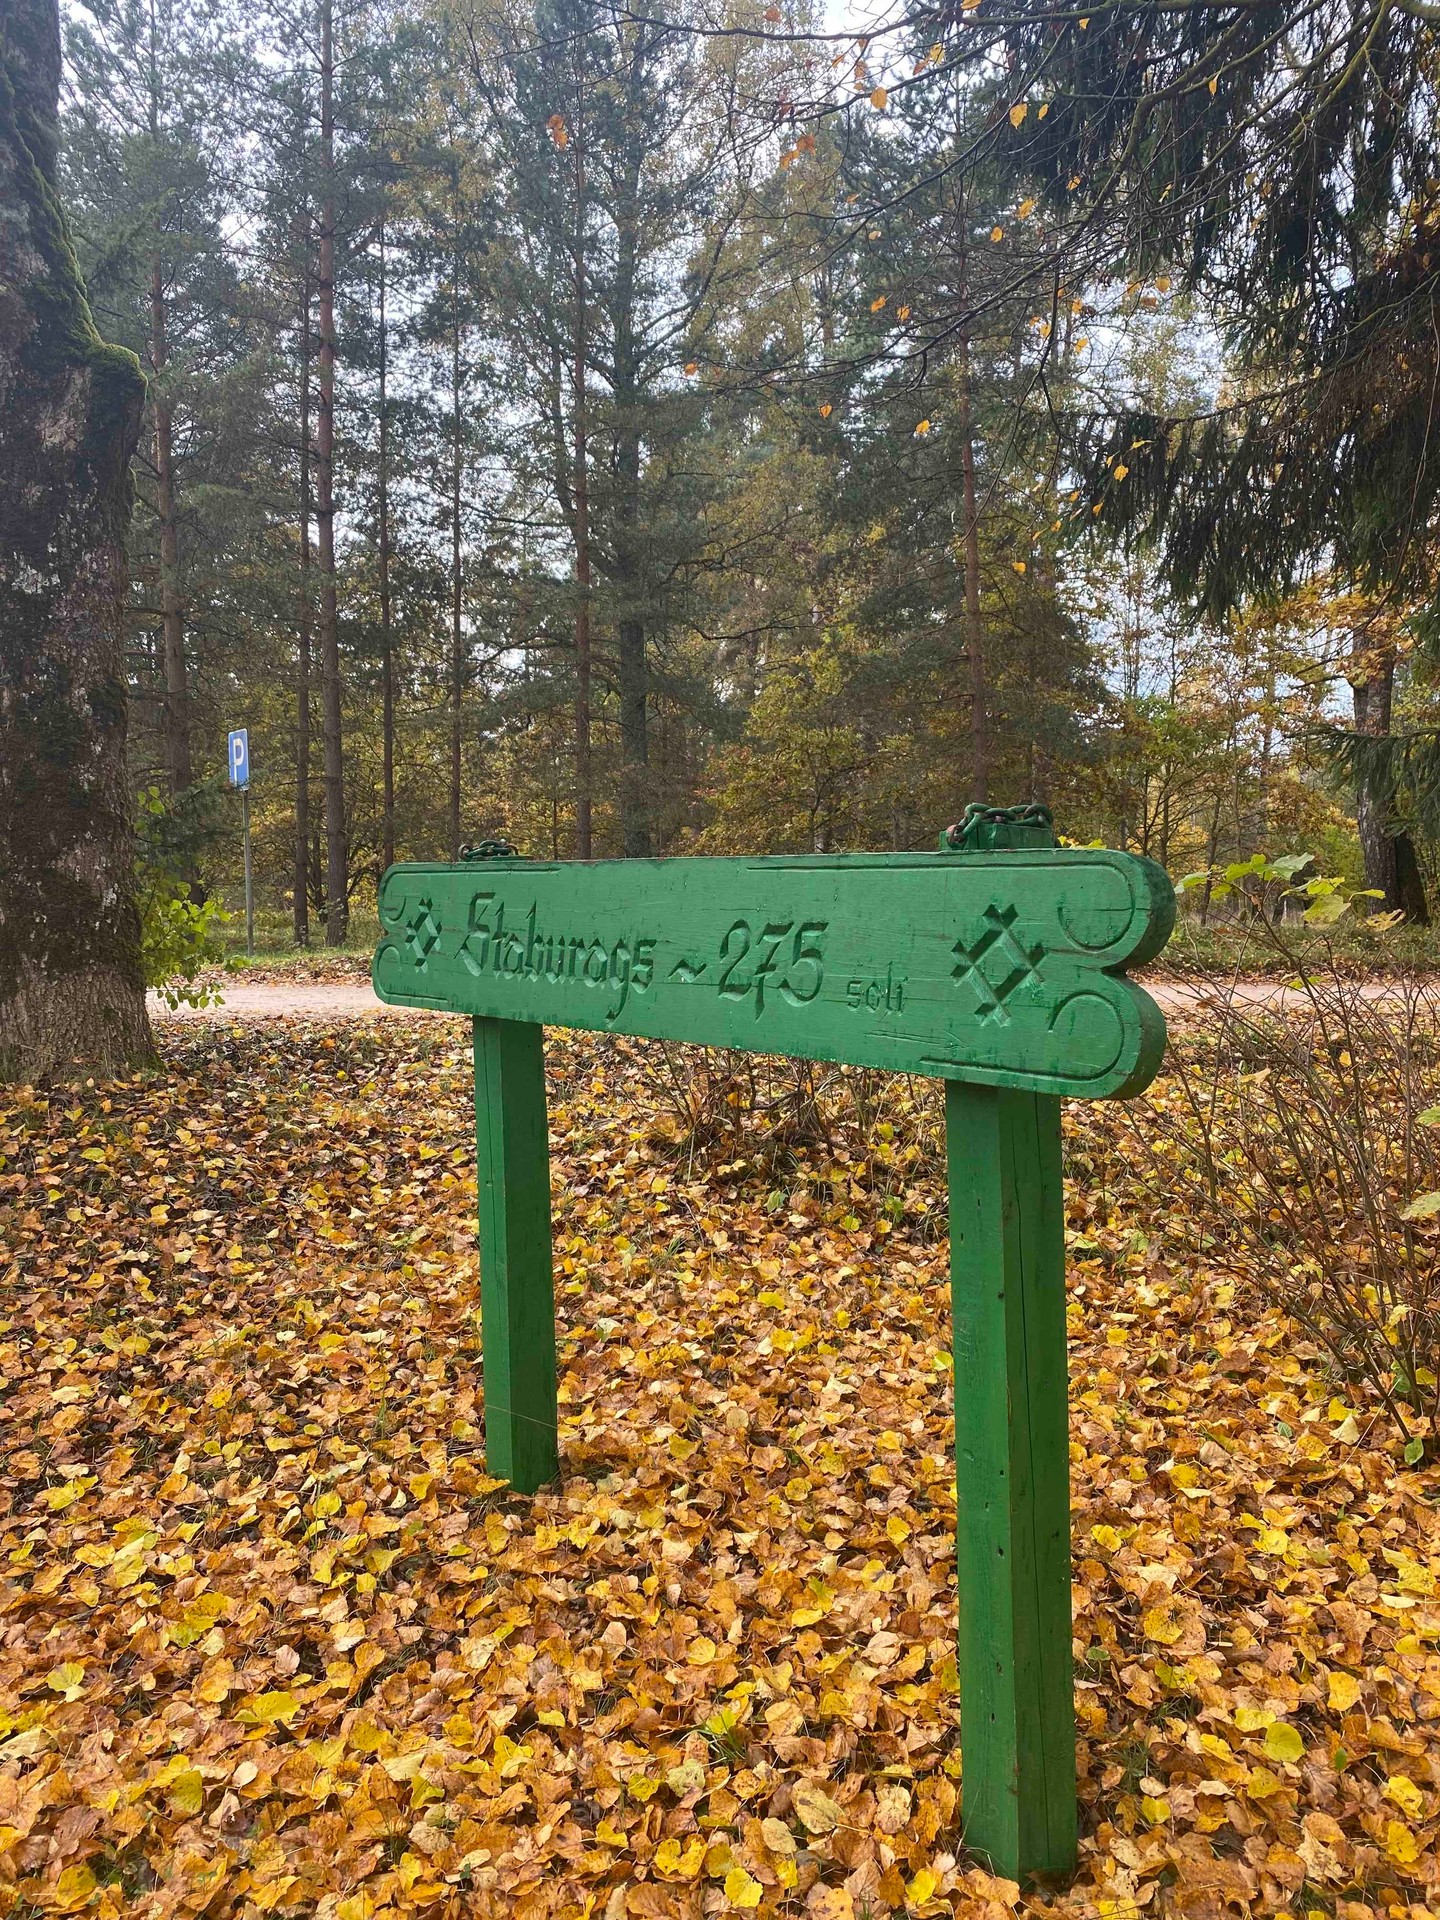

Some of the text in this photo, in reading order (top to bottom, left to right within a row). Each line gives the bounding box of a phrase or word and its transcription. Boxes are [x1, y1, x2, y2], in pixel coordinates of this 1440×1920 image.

[233, 737, 245, 788] P
[453, 892, 657, 1028] Staburags
[717, 918, 830, 1024] 275
